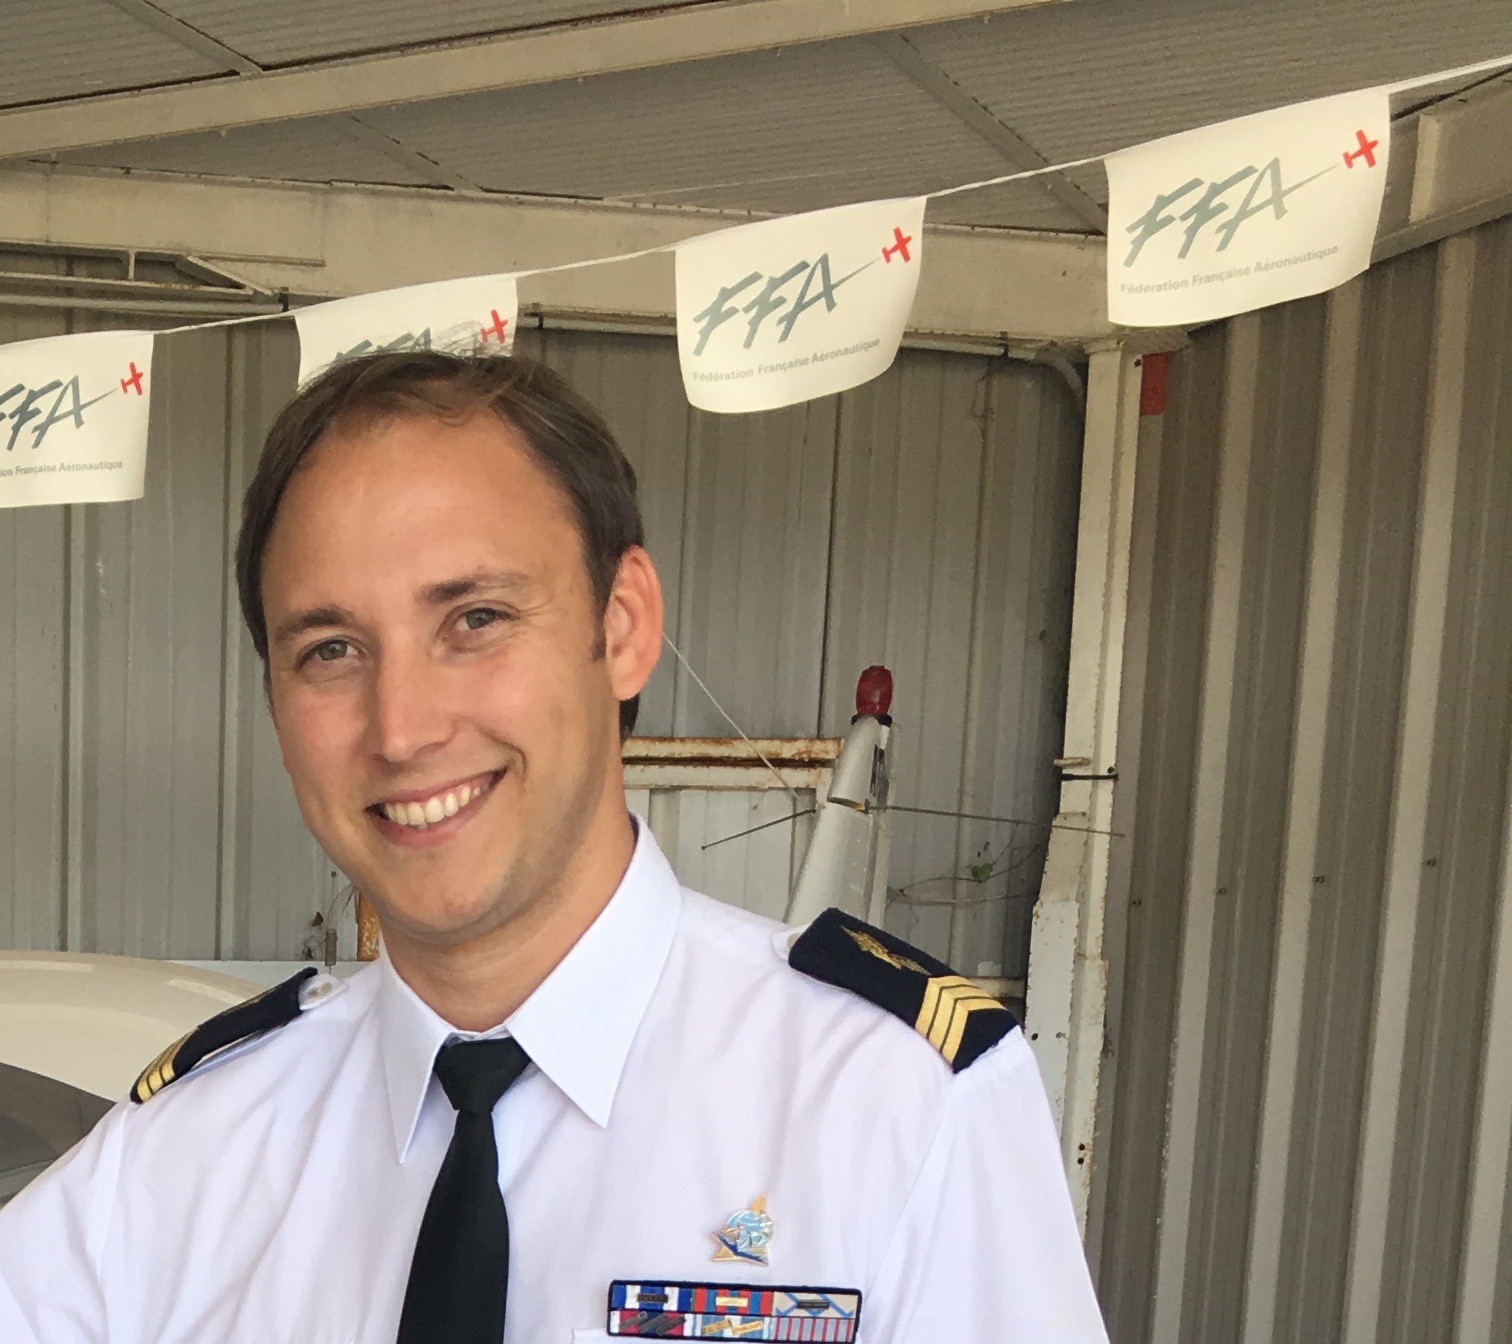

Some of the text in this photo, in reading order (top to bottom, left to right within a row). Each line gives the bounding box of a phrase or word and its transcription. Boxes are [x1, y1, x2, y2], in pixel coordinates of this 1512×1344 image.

[1122, 156, 1342, 269] FFA
[692, 252, 881, 357] FFA
[1120, 279, 1188, 295] Fédération
[1191, 267, 1251, 287] Française
[692, 368, 755, 383] Fédération
[757, 357, 810, 376] Française
